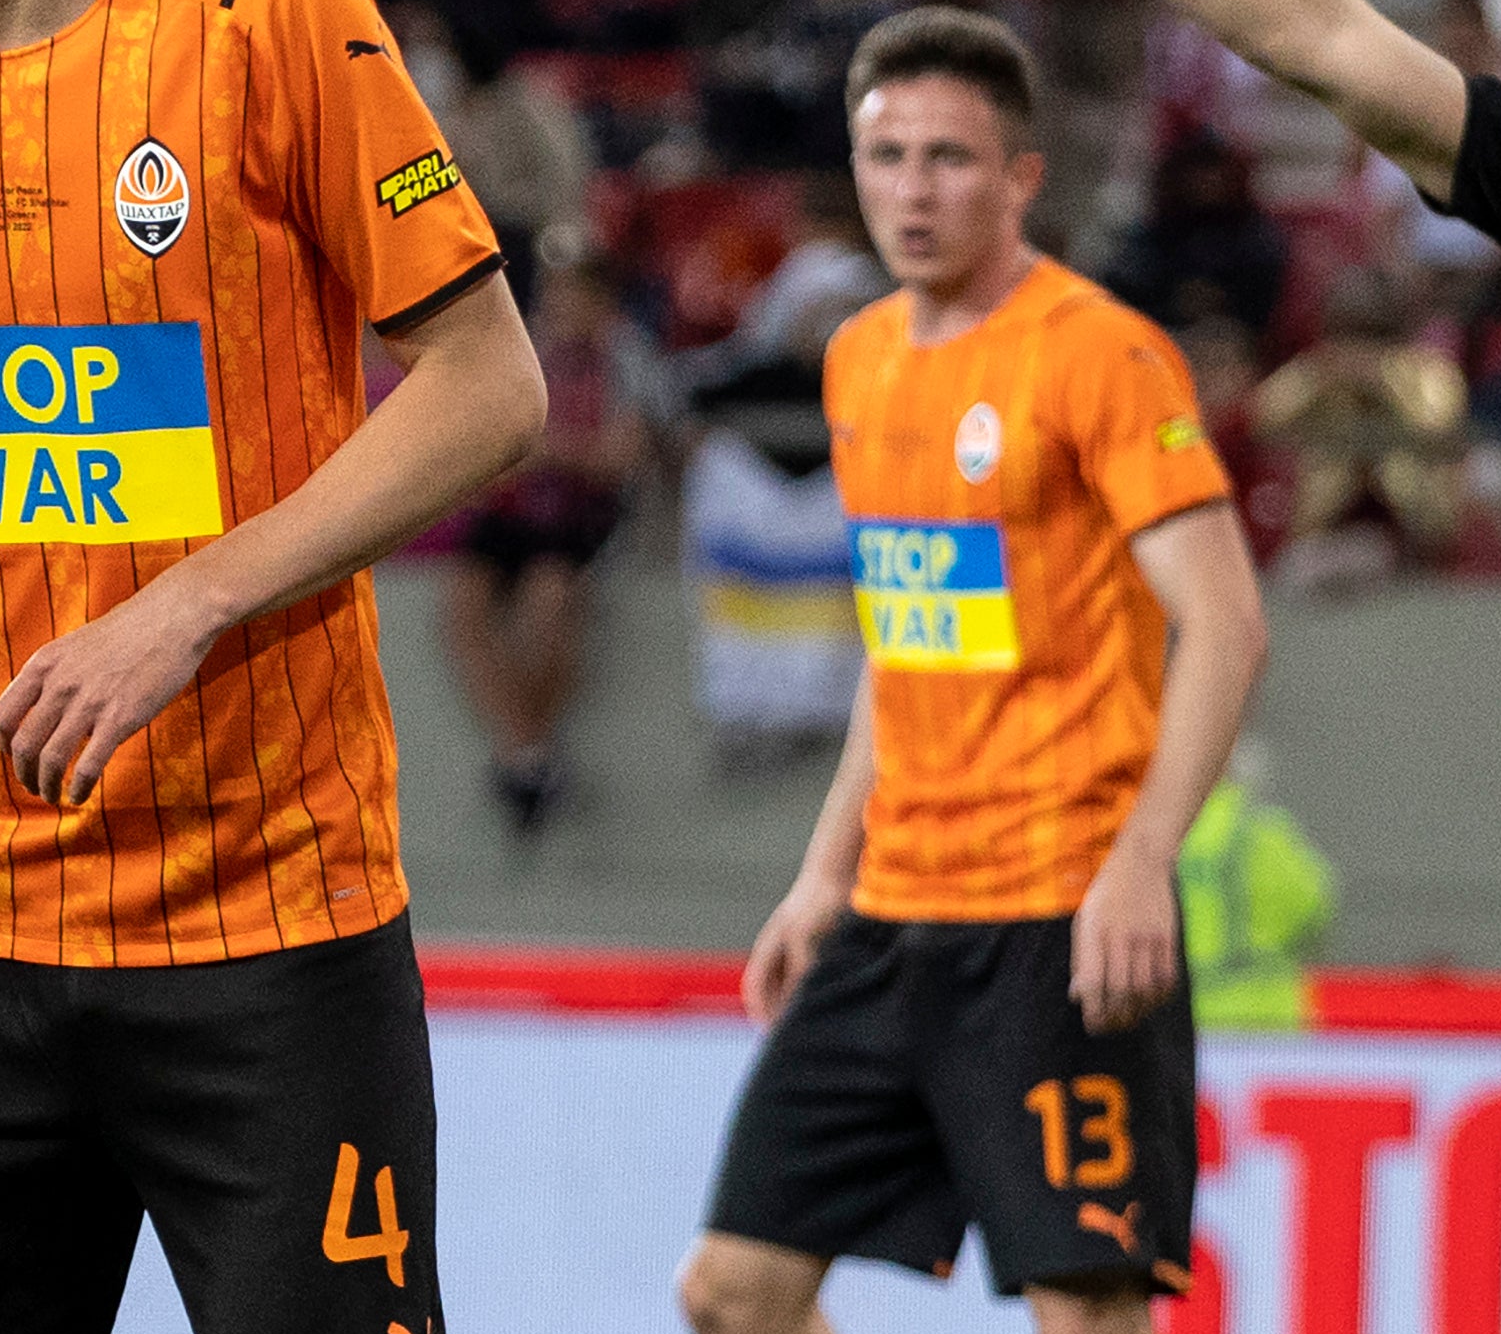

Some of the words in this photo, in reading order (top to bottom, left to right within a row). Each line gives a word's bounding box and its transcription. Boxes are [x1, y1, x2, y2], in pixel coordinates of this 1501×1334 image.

[380, 154, 440, 201] PARI
[393, 162, 460, 213] MATC
[119, 202, 185, 219] ШАХТАР
[857, 528, 959, 590] STOP
[1025, 1075, 1134, 1188] 13
[322, 1142, 409, 1288] 4
